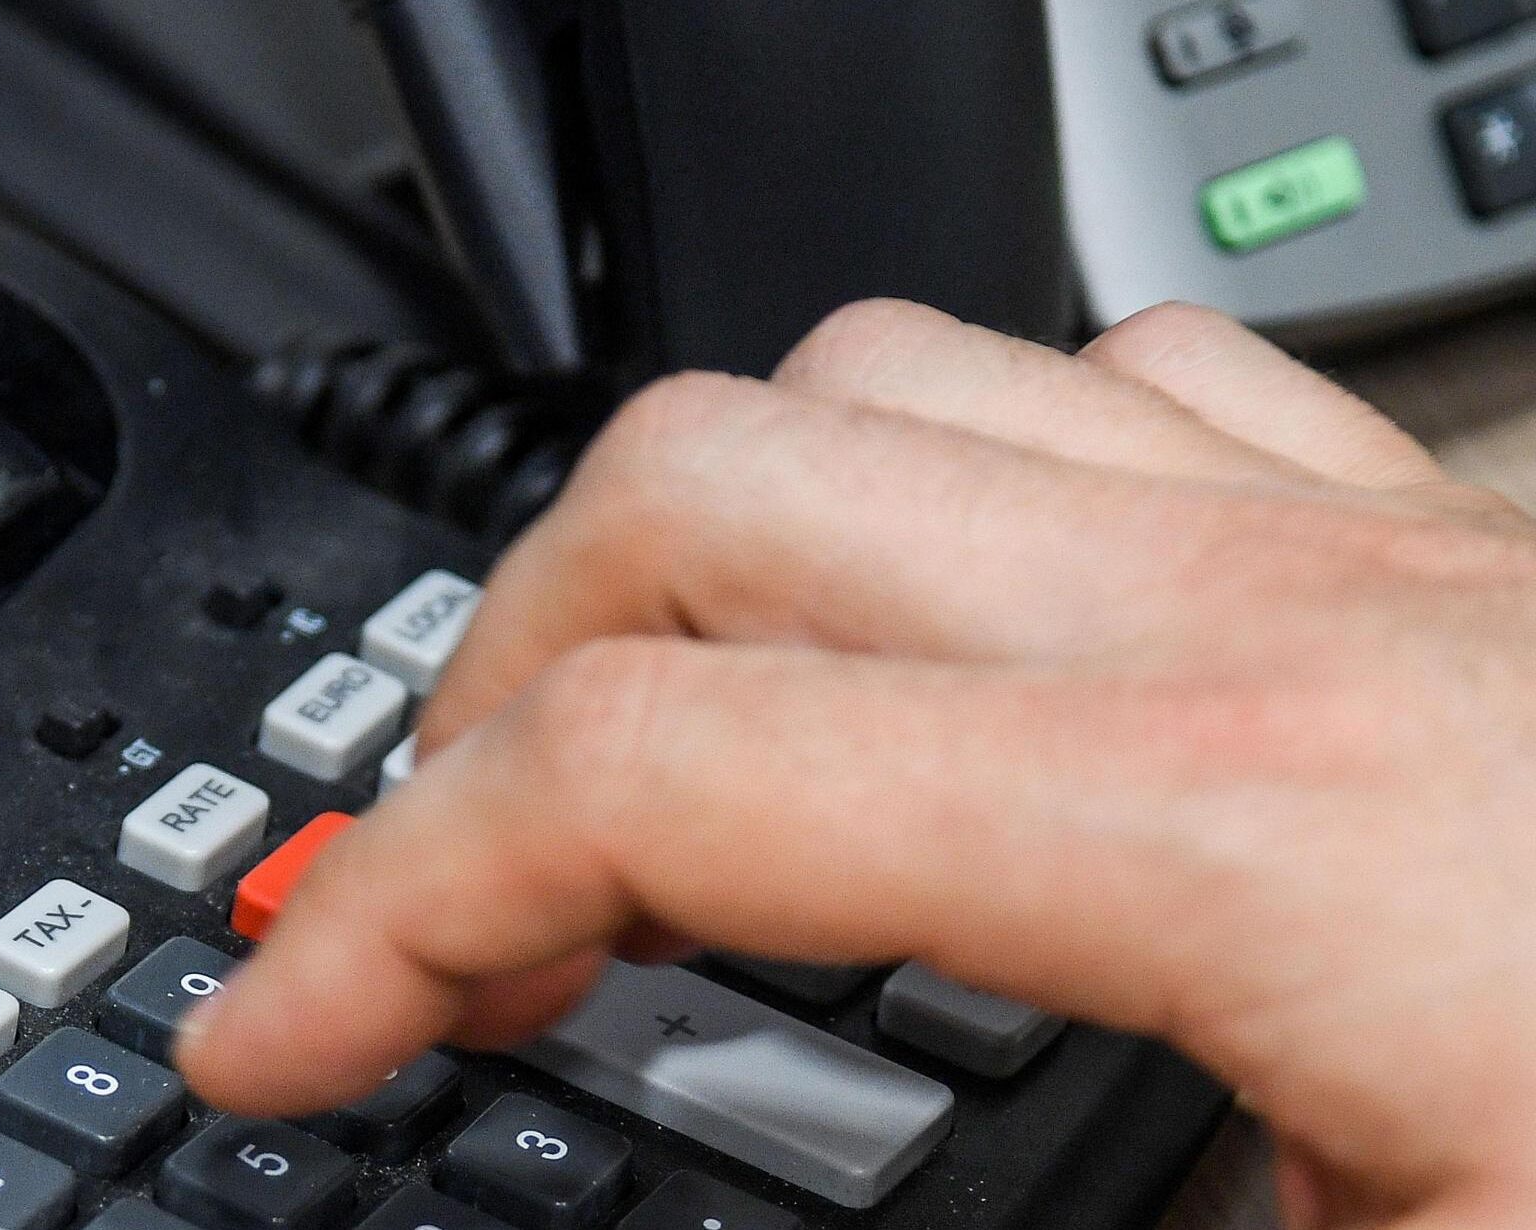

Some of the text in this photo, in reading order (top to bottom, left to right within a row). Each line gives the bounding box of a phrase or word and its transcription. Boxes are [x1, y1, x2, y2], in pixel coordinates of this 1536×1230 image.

[297, 664, 372, 723] EURO
[159, 778, 236, 833] RATE
[180, 972, 226, 997] 9
[65, 1064, 120, 1096] 8
[236, 1143, 290, 1177] 5
[515, 1129, 569, 1161] 3
